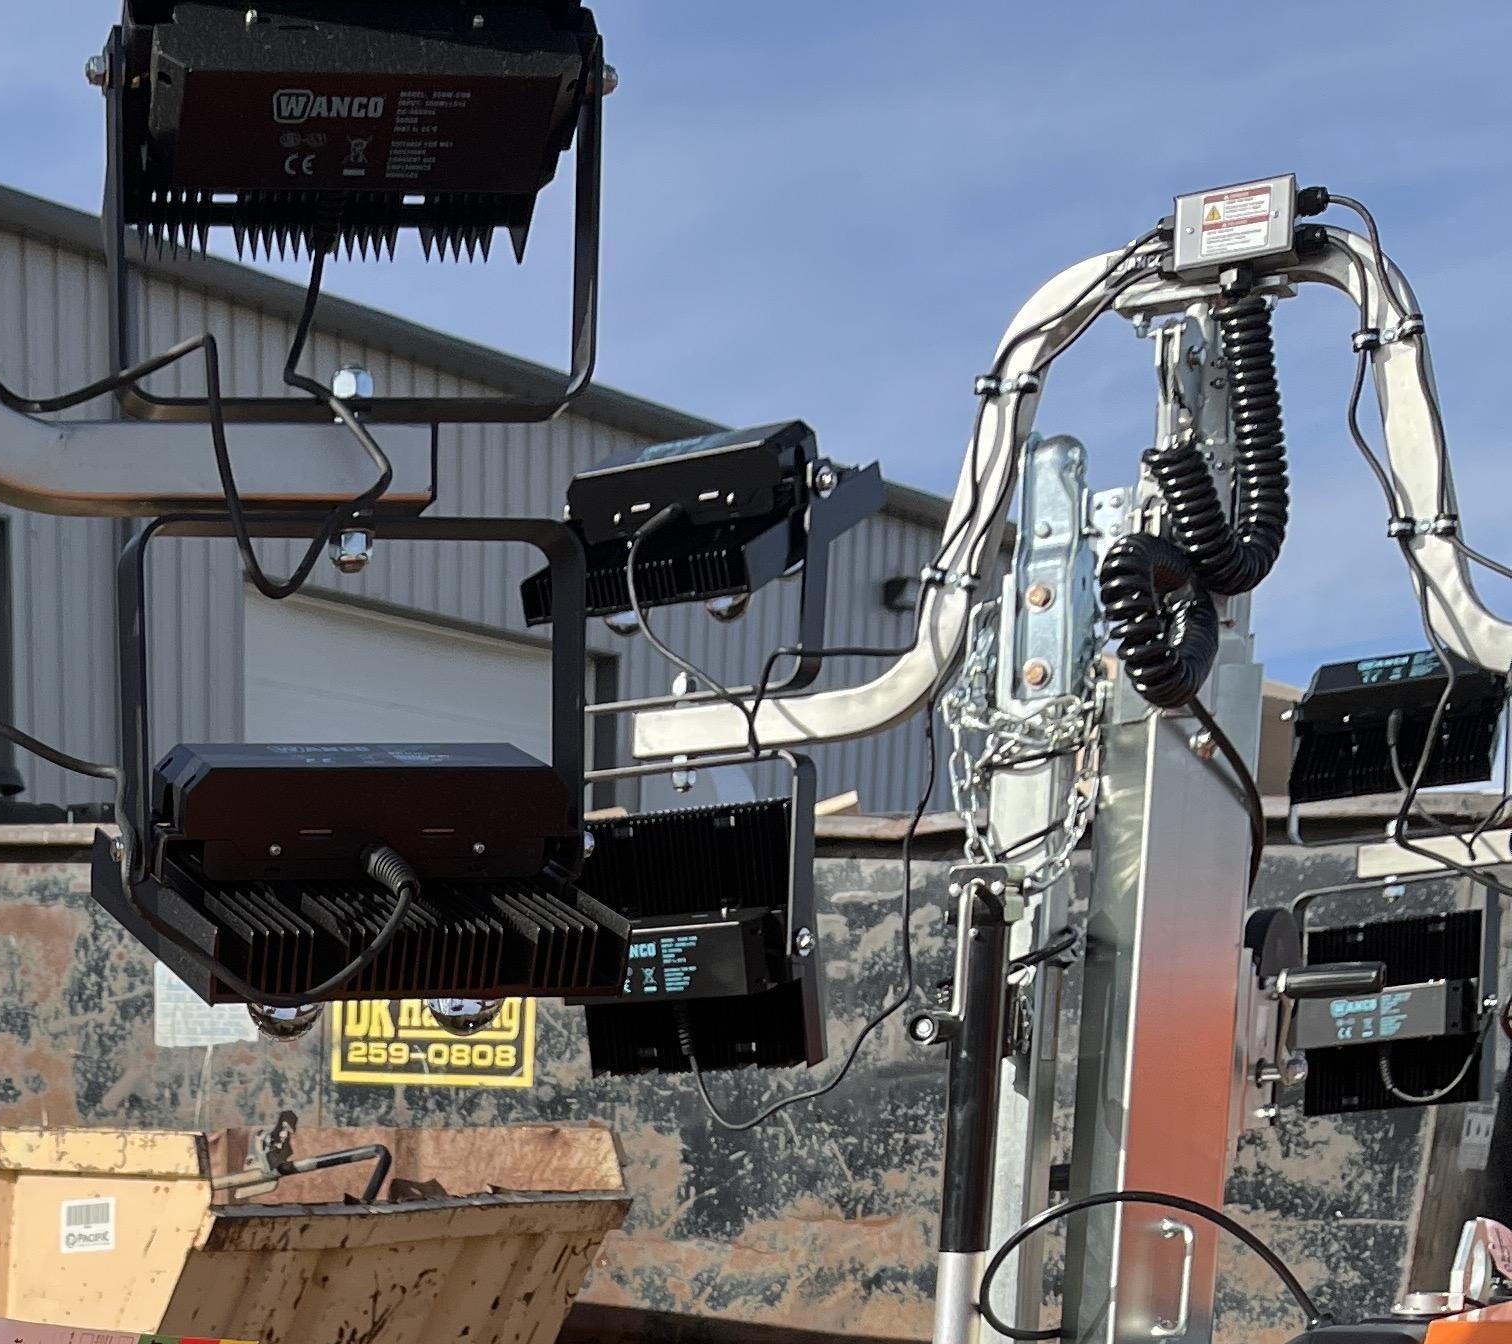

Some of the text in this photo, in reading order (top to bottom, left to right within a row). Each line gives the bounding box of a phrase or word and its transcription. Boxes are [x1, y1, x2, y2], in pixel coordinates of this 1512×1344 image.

[273, 89, 385, 123] WANCO
[629, 943, 656, 959] NCO
[347, 1041, 517, 1069] 259-0808
